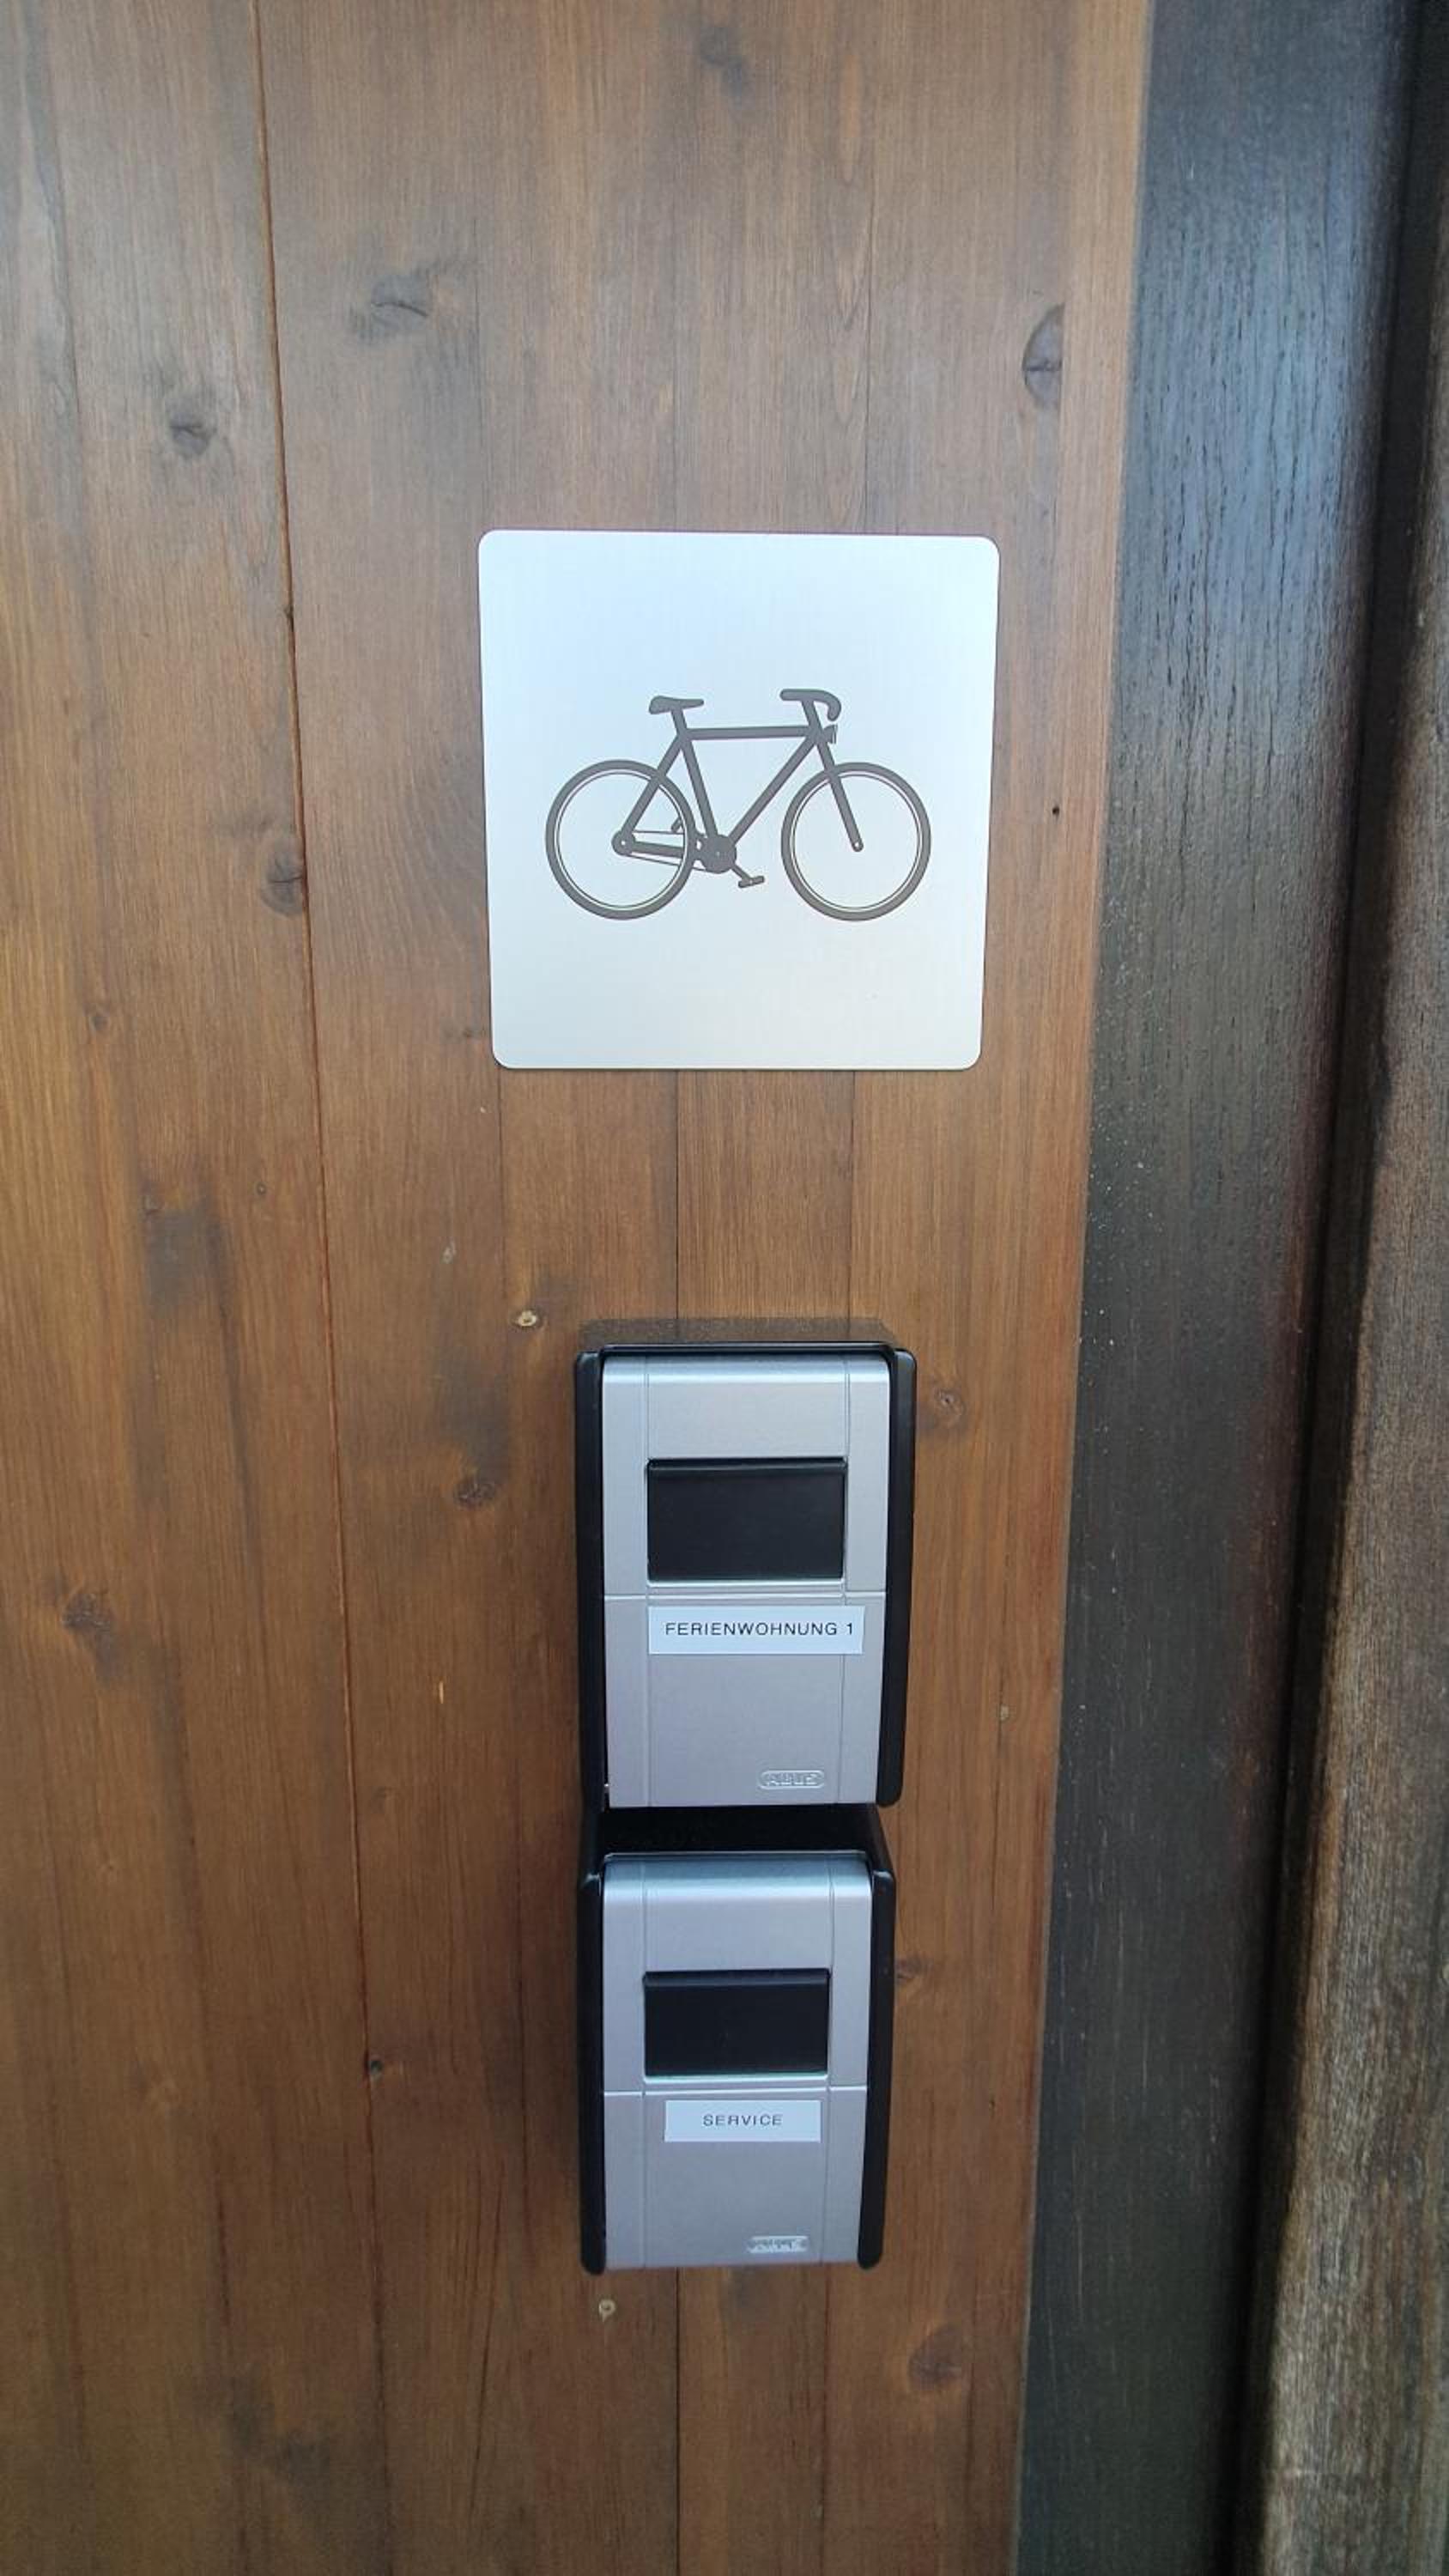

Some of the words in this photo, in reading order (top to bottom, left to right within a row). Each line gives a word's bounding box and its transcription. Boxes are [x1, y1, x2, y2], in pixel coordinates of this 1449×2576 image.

[665, 1622, 838, 1636] FERIENWOHNUNG
[846, 1622, 853, 1636] 1
[702, 2113, 783, 2127] SERVICE
